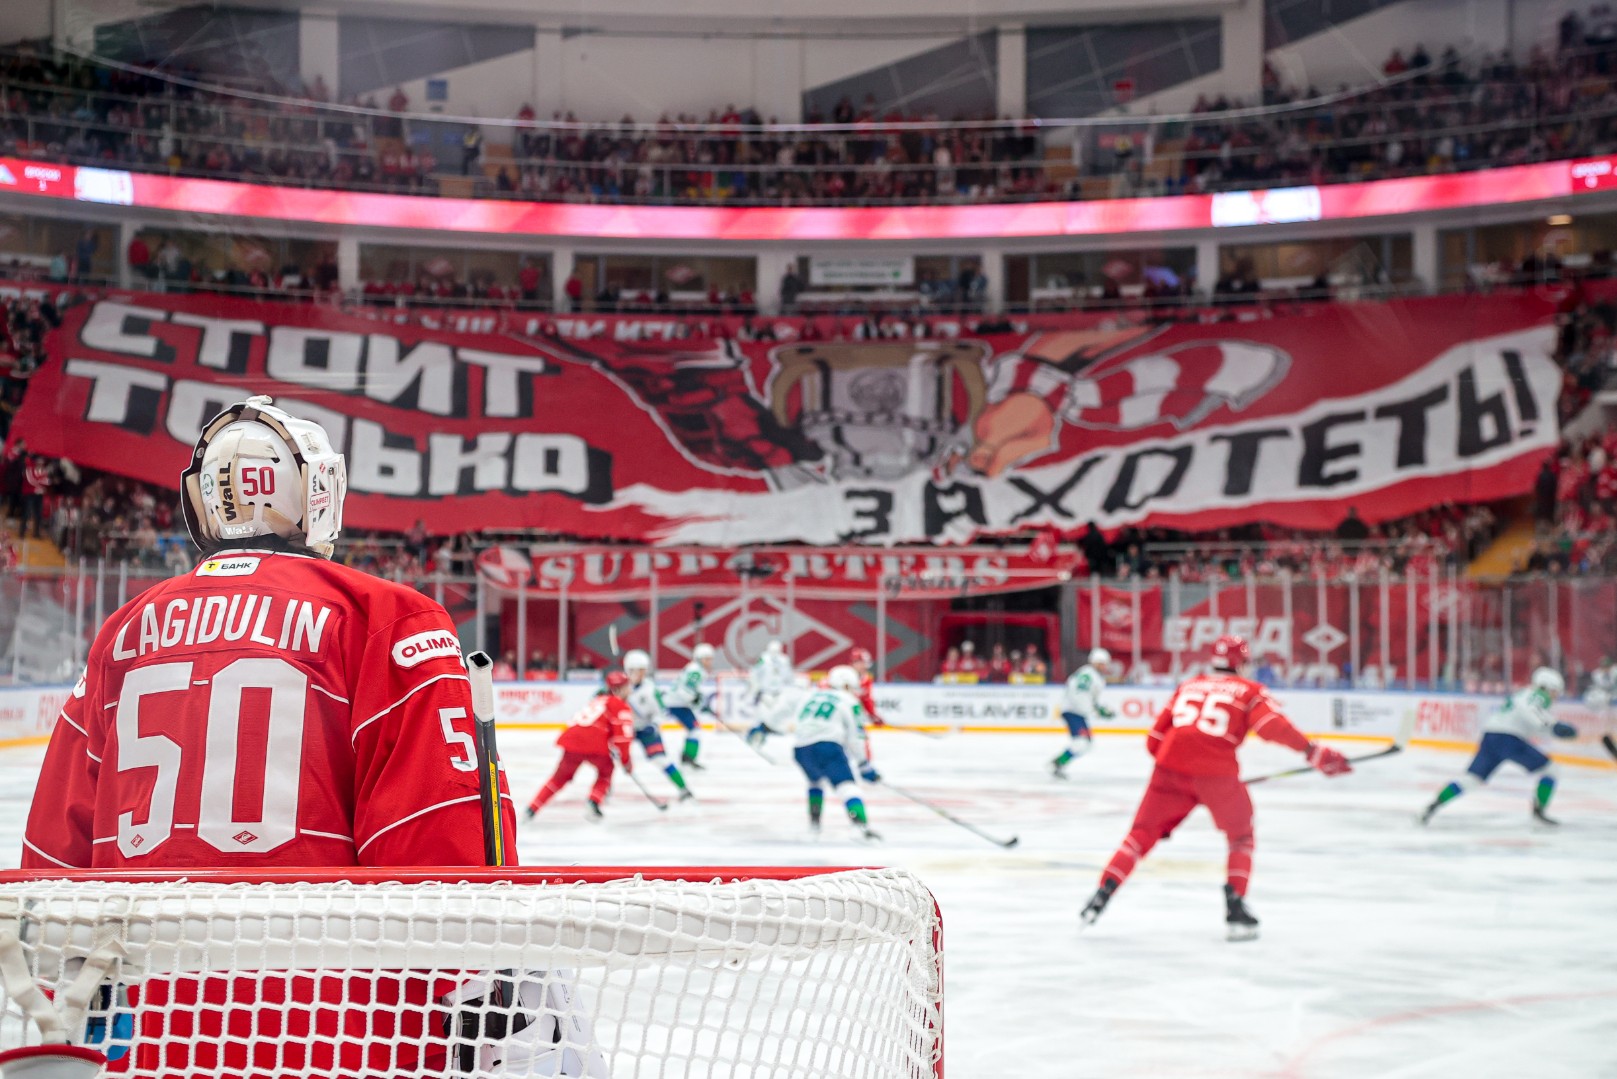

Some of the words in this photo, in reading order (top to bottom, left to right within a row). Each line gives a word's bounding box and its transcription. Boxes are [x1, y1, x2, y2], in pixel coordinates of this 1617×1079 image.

[81, 302, 546, 418] СТОИТ
[241, 466, 275, 497] 50
[220, 562, 252, 570] БАНК
[1172, 691, 1231, 738] 55
[116, 657, 308, 859] 50
